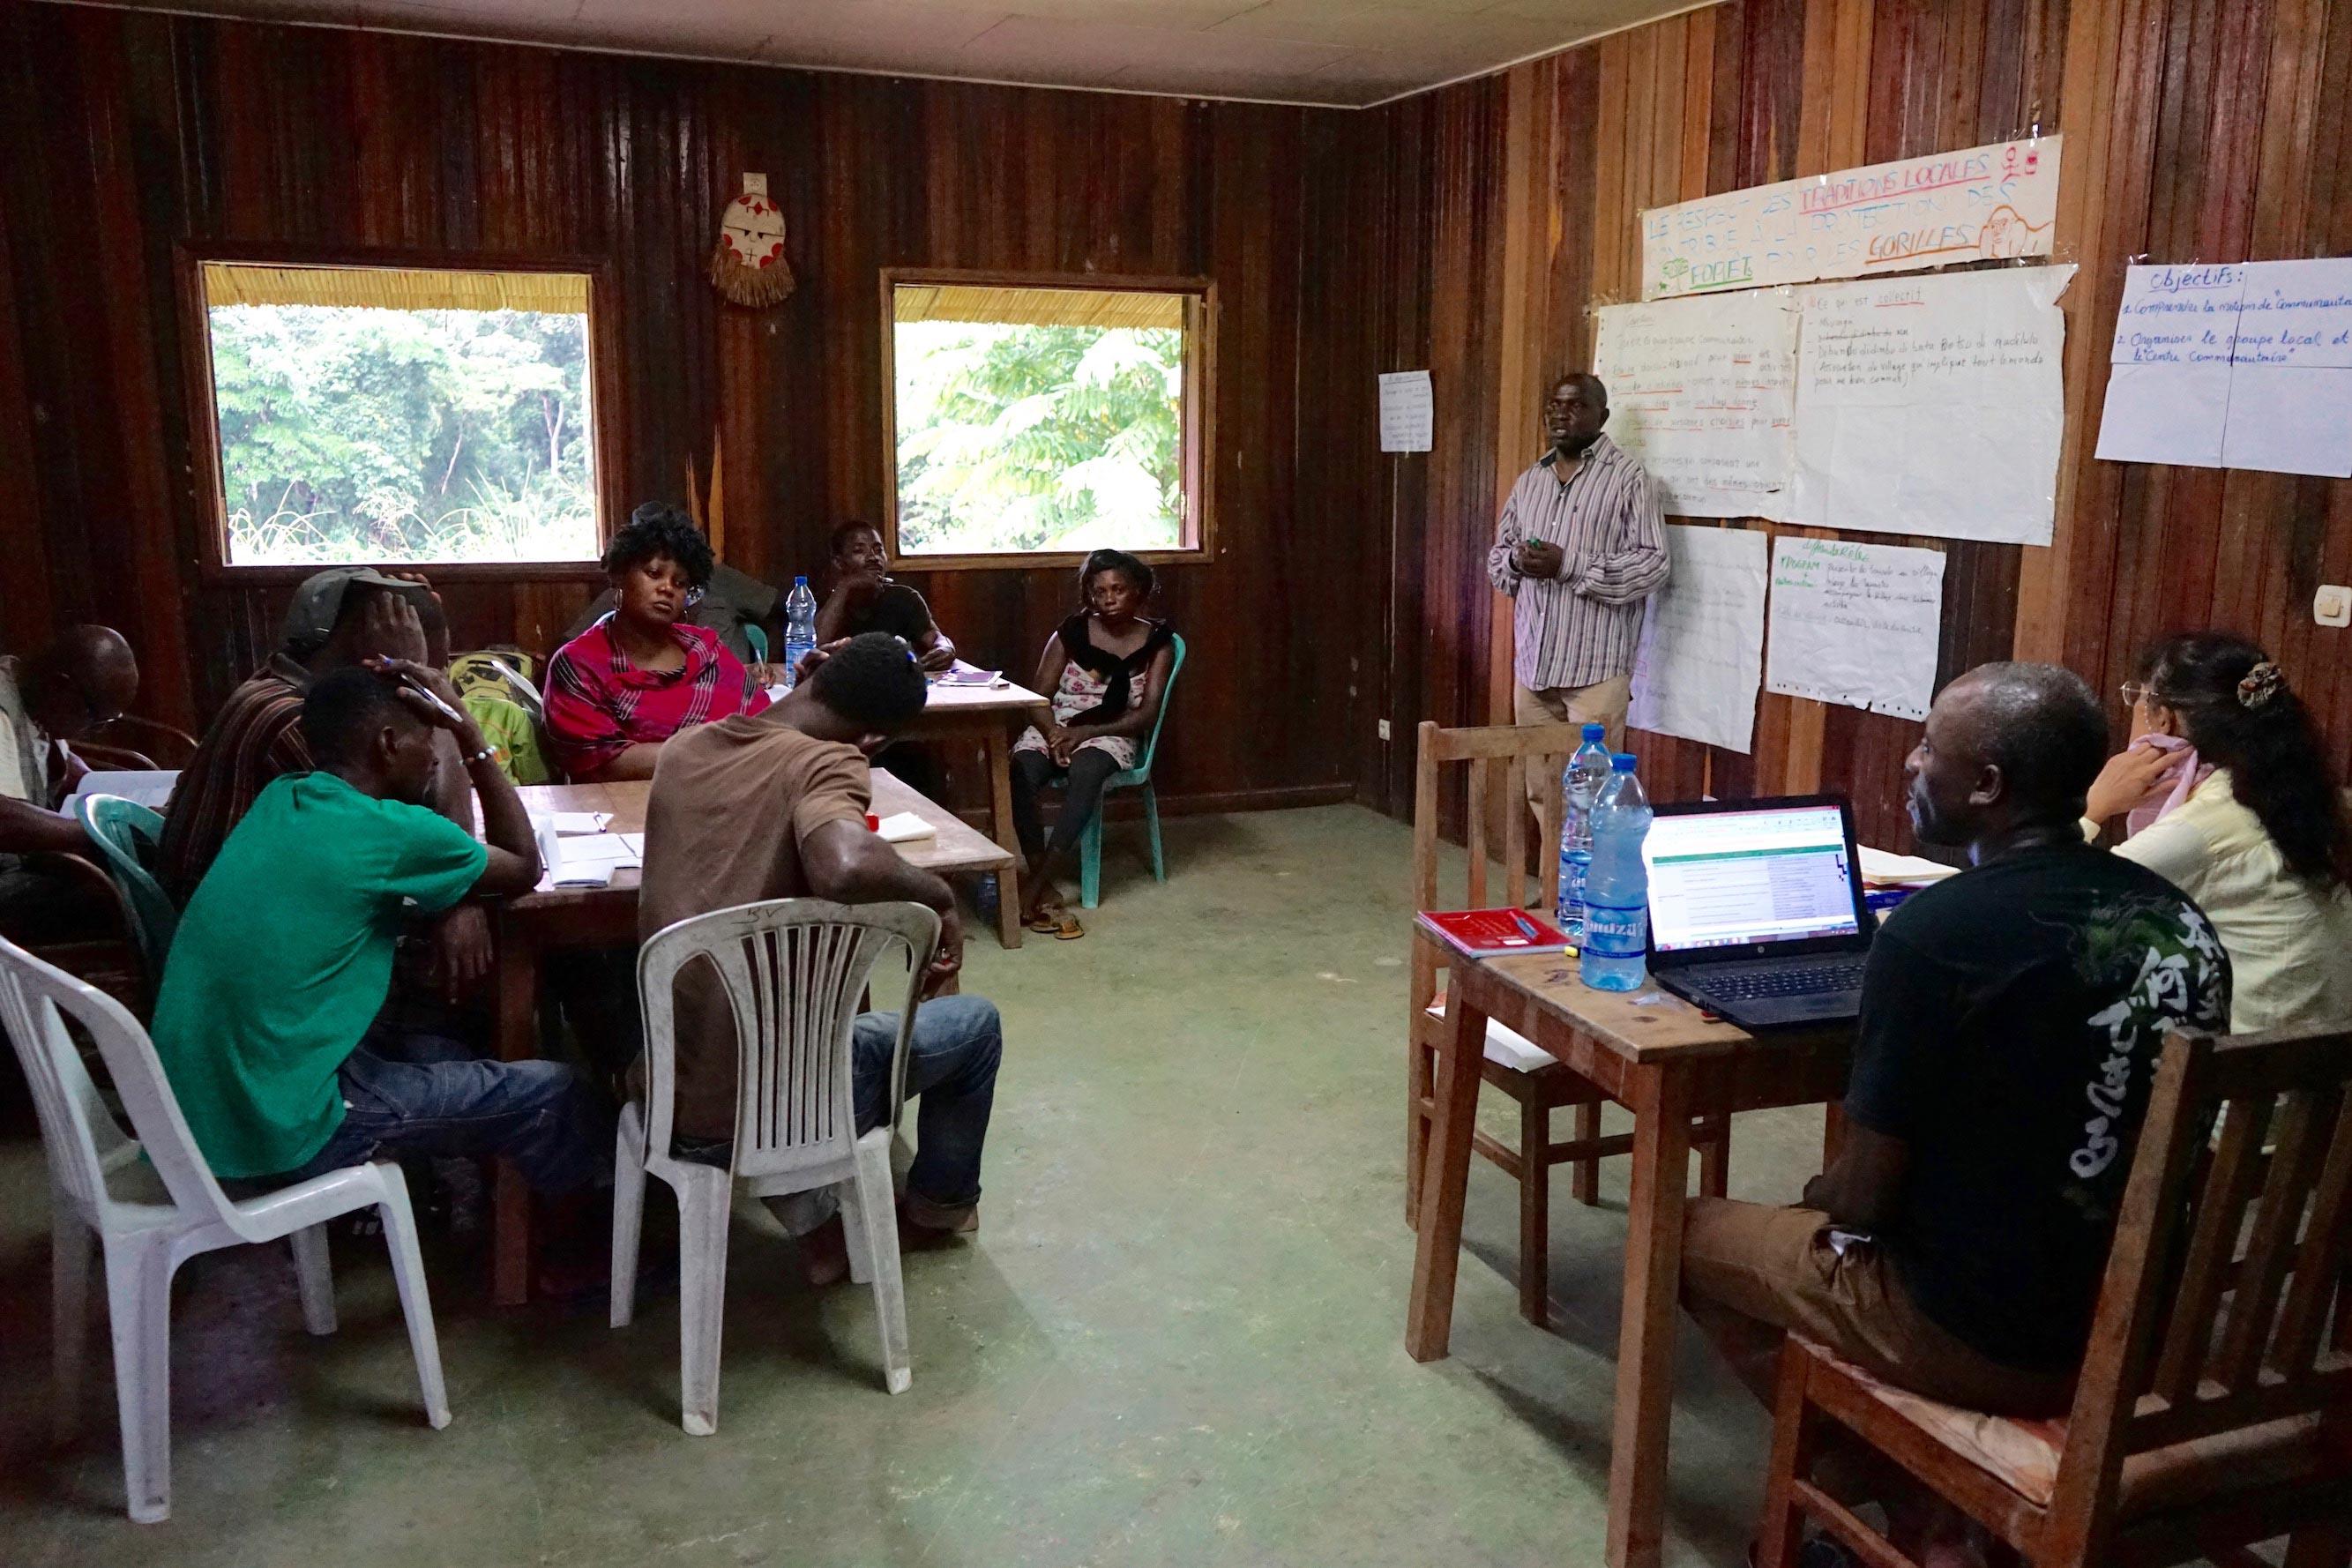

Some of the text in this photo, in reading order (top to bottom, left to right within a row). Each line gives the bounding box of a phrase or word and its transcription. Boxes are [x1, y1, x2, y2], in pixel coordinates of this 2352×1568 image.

[1649, 213, 1669, 240] LE
[1903, 153, 1991, 189] LOCALES
[1967, 181, 2017, 209] DES
[1869, 224, 1976, 258] GORILLES
[1878, 286, 1922, 303] collectif
[2204, 299, 2215, 312] la
[2258, 298, 2274, 311] de
[2225, 334, 2274, 351] groupe
[2281, 330, 2321, 346] local
